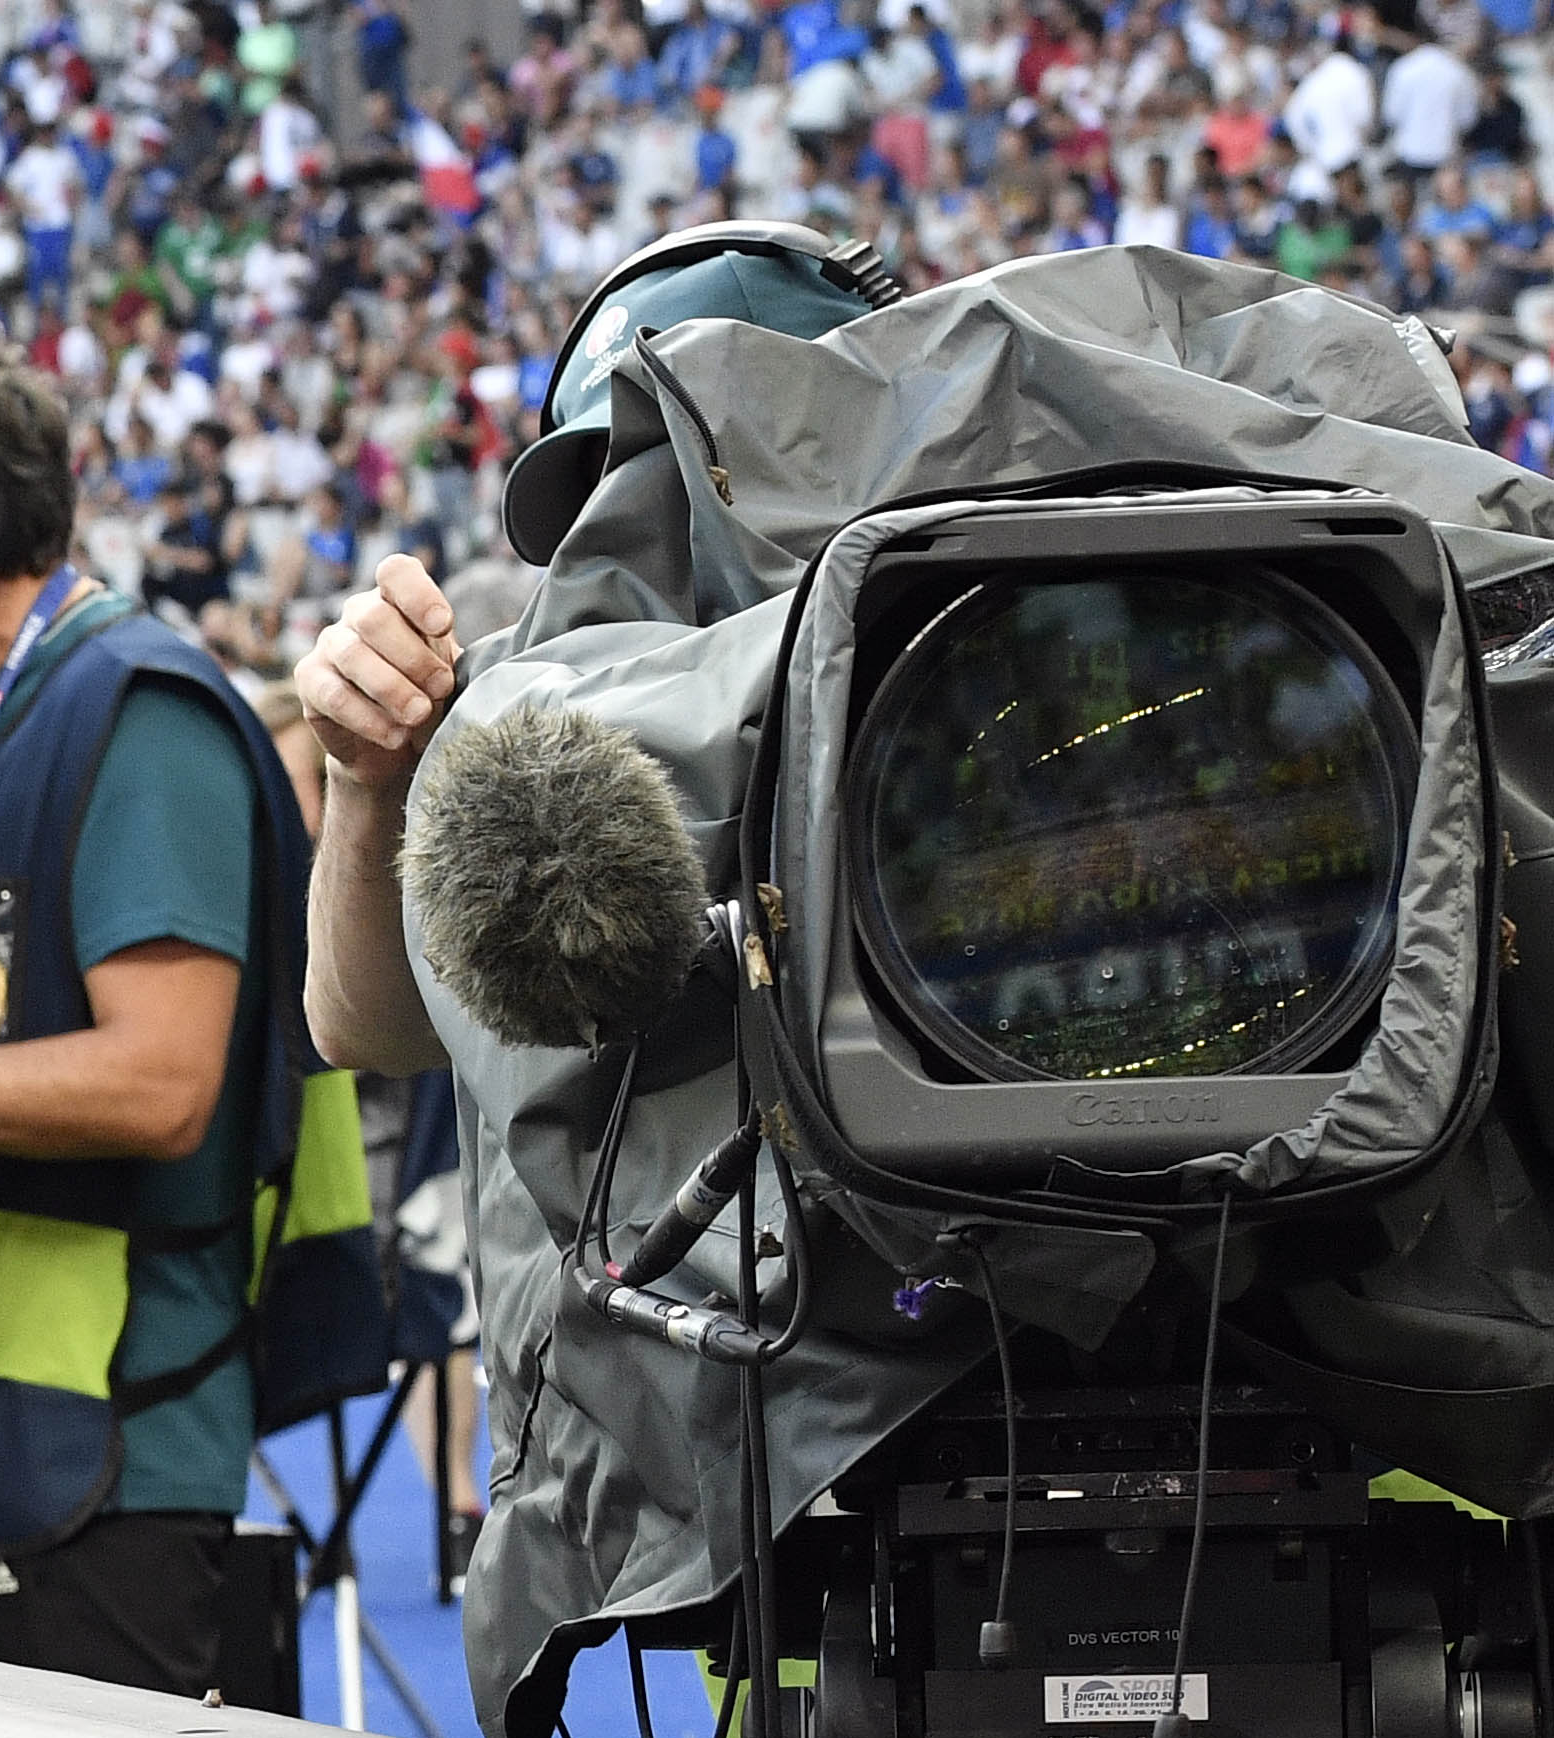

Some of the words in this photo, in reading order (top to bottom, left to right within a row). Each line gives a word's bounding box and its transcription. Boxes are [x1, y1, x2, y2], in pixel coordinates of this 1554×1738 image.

[1068, 1093, 1220, 1127] Canon
[1068, 1633, 1098, 1646] DVS
[1101, 1630, 1160, 1645] VECTOR
[1074, 1692, 1120, 1702] DIGITAL
[1122, 1691, 1159, 1701] VIDEO
